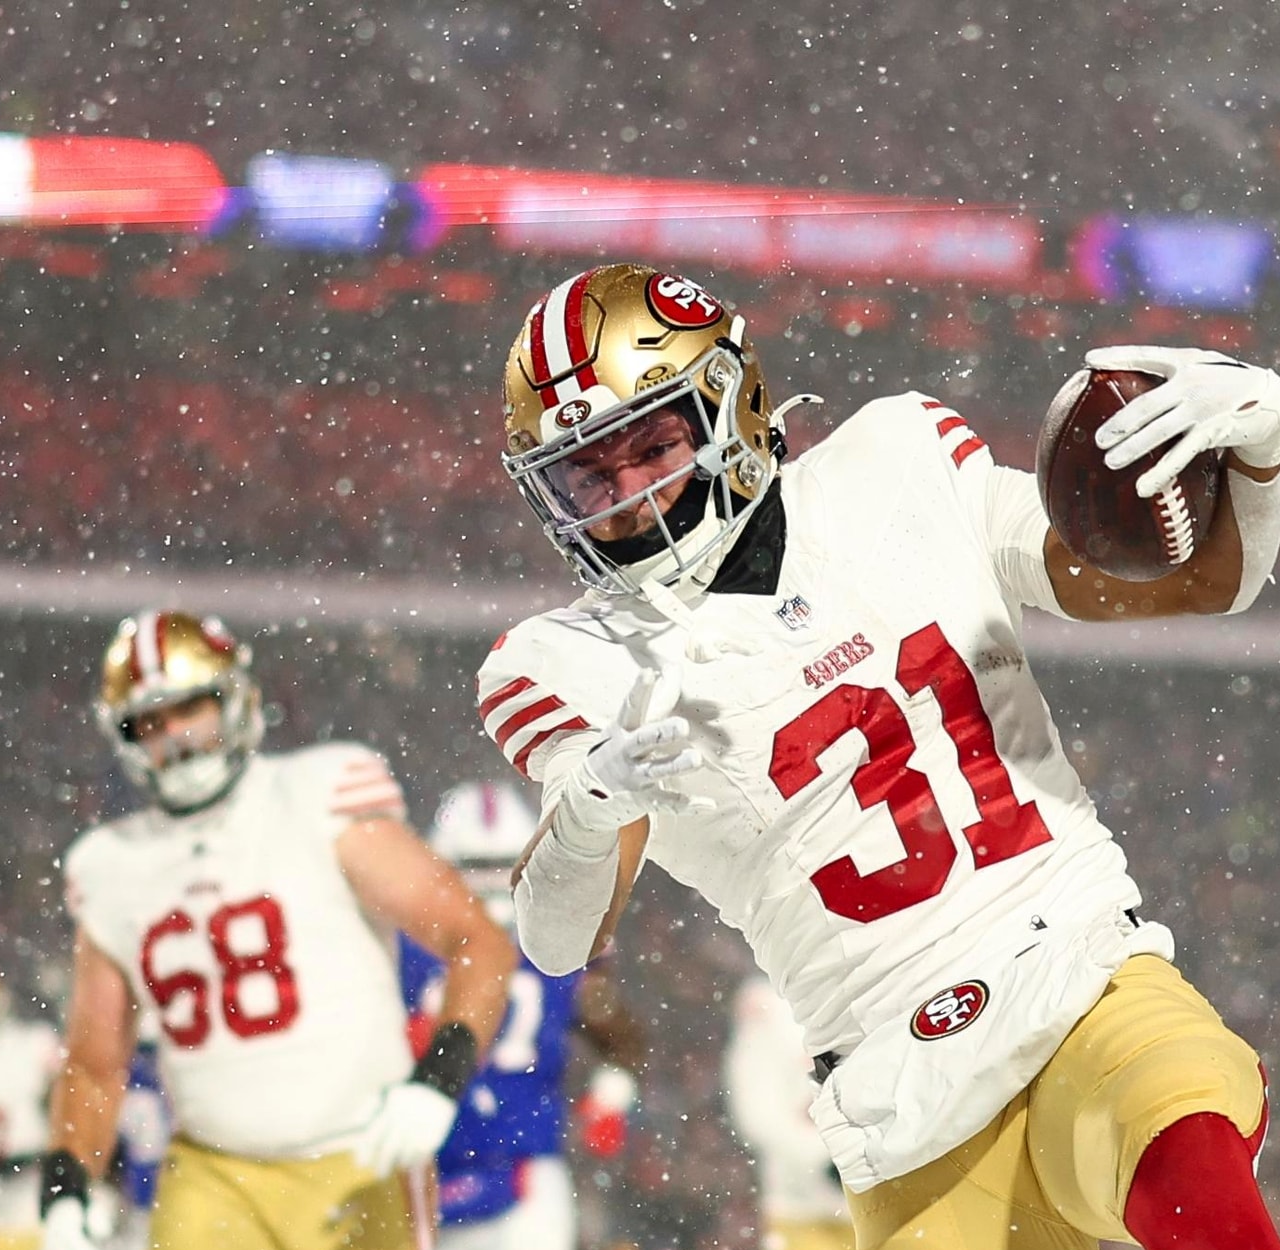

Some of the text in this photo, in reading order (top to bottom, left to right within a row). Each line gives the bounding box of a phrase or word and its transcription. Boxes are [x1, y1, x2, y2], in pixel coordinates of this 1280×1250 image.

[803, 632, 875, 690] 49ERS
[768, 620, 1055, 925] 31
[140, 893, 301, 1050] 68
